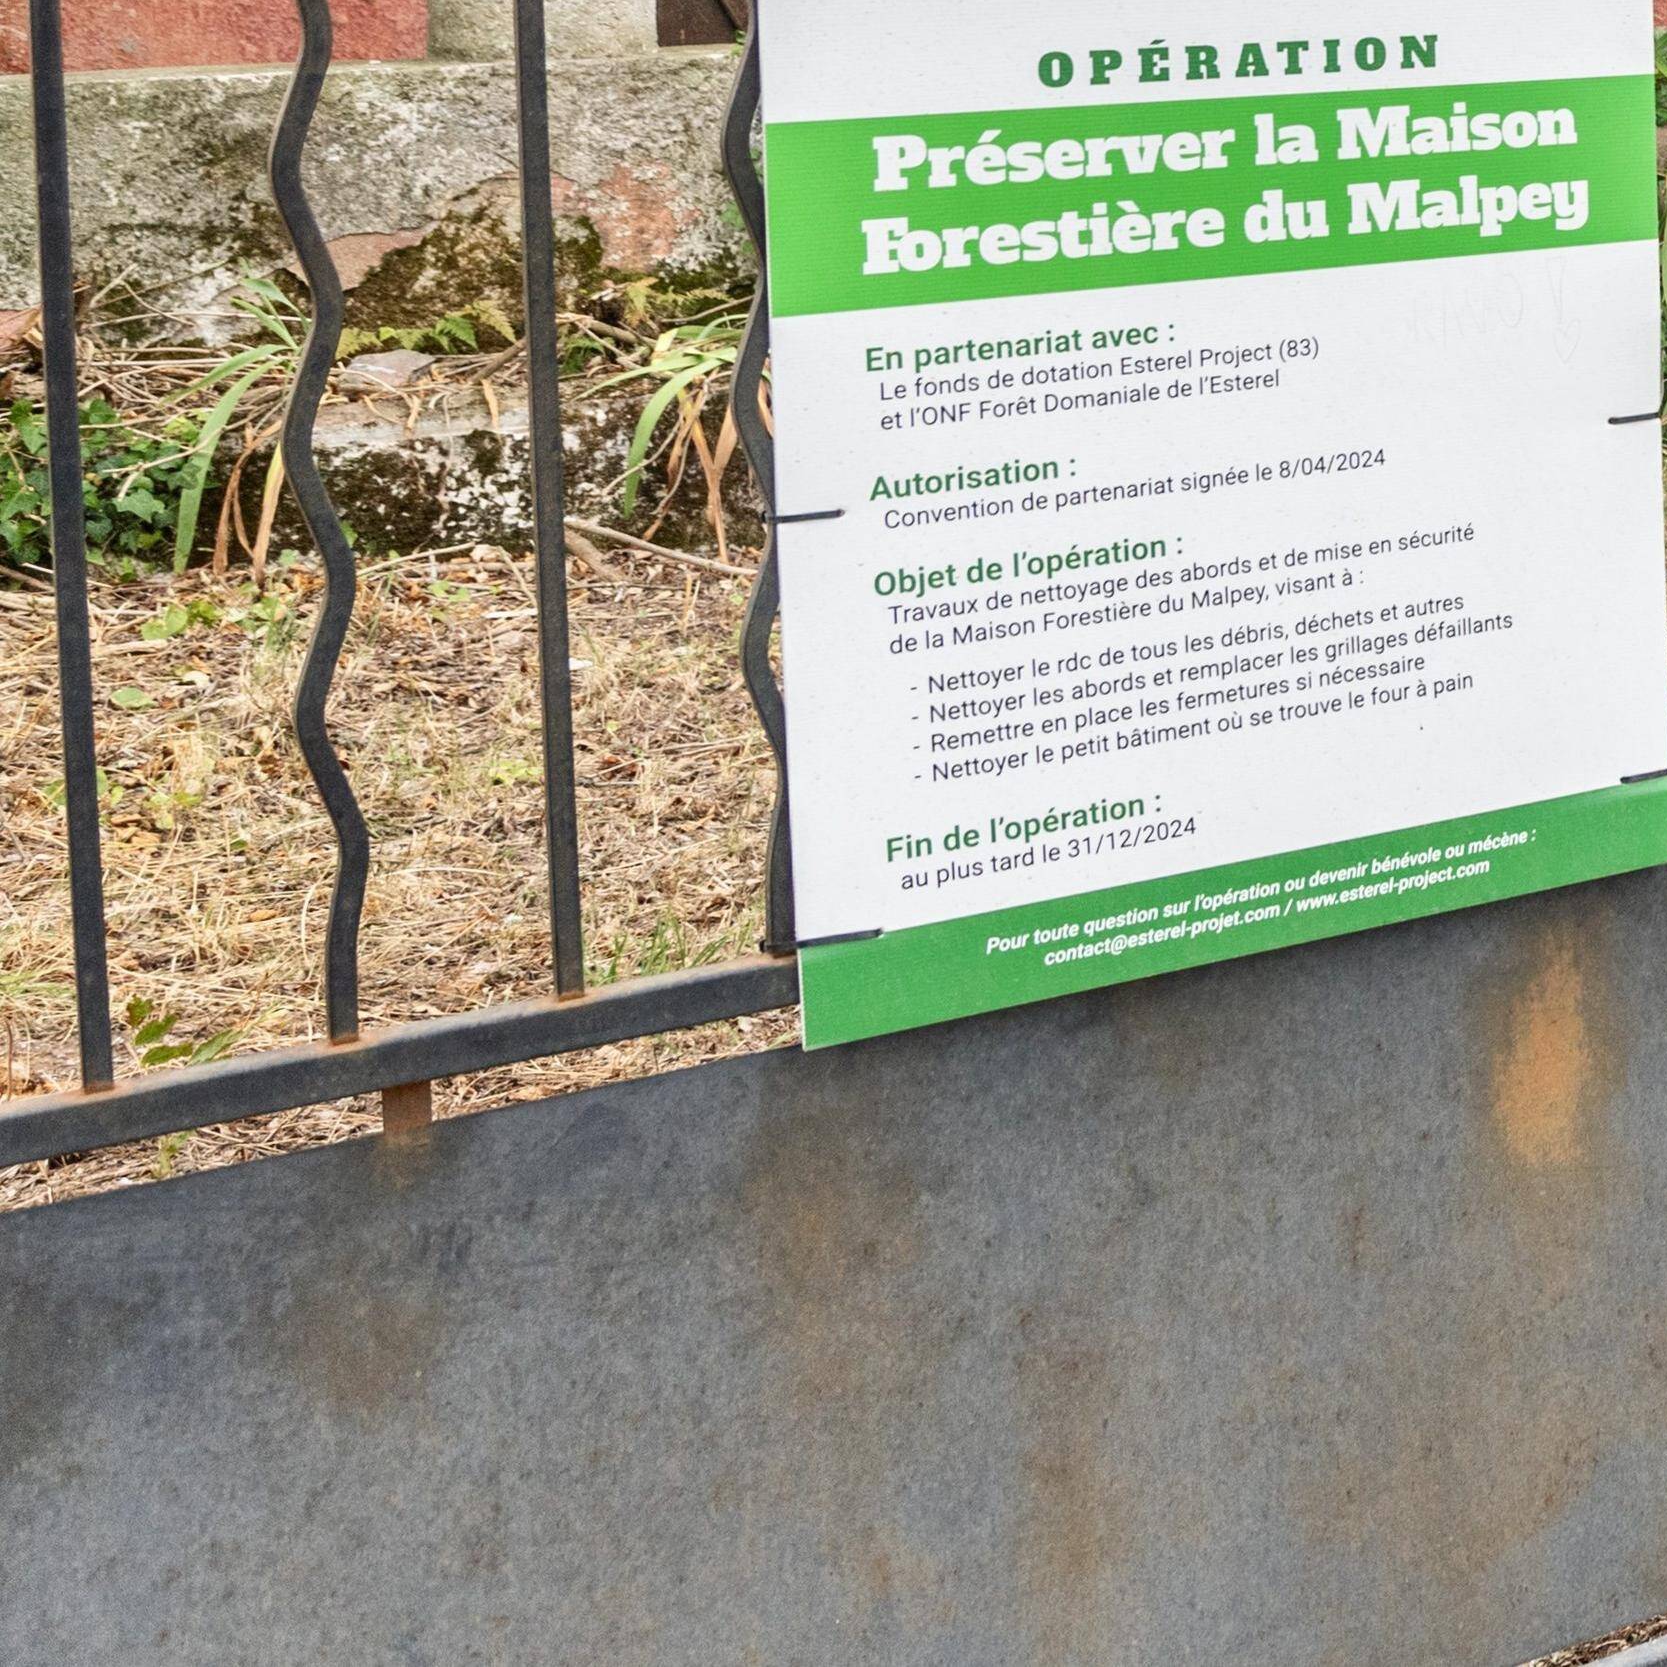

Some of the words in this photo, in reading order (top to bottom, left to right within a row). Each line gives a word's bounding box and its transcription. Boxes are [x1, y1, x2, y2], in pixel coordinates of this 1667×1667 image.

[1037, 33, 1439, 89] OPÉRATION
[871, 128, 1236, 193] Préserver
[1253, 112, 1320, 166] la
[1335, 100, 1579, 160] Maison
[860, 199, 1225, 276] Forestière
[1243, 188, 1330, 244] du
[1346, 173, 1590, 238] Malpey
[865, 346, 903, 373] En
[914, 328, 1083, 373] partenariat
[1091, 325, 1159, 350] avec
[879, 381, 908, 401] Le
[913, 372, 980, 397] fonds
[986, 368, 1015, 390] de
[1020, 360, 1113, 386] dotation
[1119, 349, 1193, 376] Esterel
[1199, 343, 1273, 369] Project
[1278, 336, 1319, 363] (83)
[880, 410, 903, 431] et
[978, 395, 1037, 420] Forêt
[1043, 382, 1161, 413] Domaniale
[1166, 378, 1193, 399] de
[869, 458, 1059, 502] Autorisation
[883, 498, 1014, 530] Convention
[1020, 491, 1049, 512] de
[1054, 476, 1174, 513] partenariat
[1180, 465, 1249, 494] signée
[1255, 462, 1273, 482] le
[1278, 448, 1386, 479] 8/04/2024
[873, 563, 957, 597] Objet
[965, 556, 1003, 584] de
[887, 597, 979, 625] Travaux
[985, 589, 1013, 611] de
[1020, 576, 1129, 606] nettoyage
[1134, 568, 1173, 590] des
[1179, 555, 1252, 583] abords
[1257, 552, 1278, 572] et
[1283, 547, 1308, 568] de
[1314, 541, 1363, 564] mise
[1368, 538, 1392, 555] en
[1397, 521, 1475, 551] sécurité
[889, 633, 918, 655] de
[924, 629, 944, 650] la
[952, 618, 1036, 646] Maison
[1042, 600, 1152, 632] Forestière
[1157, 593, 1184, 615] du
[1190, 584, 1270, 609] Malpey,
[1274, 571, 1336, 596] visant
[1341, 567, 1353, 587] à
[927, 664, 1025, 694] Nettoyer
[1031, 657, 1051, 678] le
[1057, 651, 1092, 674] rdc
[1097, 646, 1125, 668] de
[1129, 640, 1178, 662] tous
[1184, 633, 1215, 654] les
[1220, 623, 1289, 648] débris,
[1294, 609, 1374, 636] déchets
[1379, 603, 1399, 622] et
[1403, 595, 1465, 619] autres
[929, 693, 1026, 723] Nettoyer
[1032, 686, 1065, 707] les
[1071, 671, 1147, 701] abords
[1152, 667, 1173, 687] et
[1179, 651, 1284, 683] remplacer
[1289, 645, 1319, 665] les
[1324, 631, 1409, 663] grillages
[1413, 614, 1513, 644] défaillants
[930, 721, 1034, 753] Remettre
[1040, 716, 1068, 734] en
[1074, 705, 1133, 734] place
[1139, 698, 1170, 718] les
[1175, 678, 1290, 711] fermetures
[1295, 670, 1312, 691] si
[1318, 655, 1425, 687] nécessaire
[932, 751, 1029, 782] Nettoyer
[1035, 744, 1054, 764] le
[1060, 734, 1110, 765] petit
[1115, 717, 1211, 751] bâtiment
[1216, 710, 1243, 733] où
[1248, 709, 1273, 727] se
[1278, 697, 1343, 722] trouve
[1347, 690, 1365, 709] le
[1370, 685, 1411, 705] four
[1415, 678, 1428, 698] à
[1432, 672, 1473, 699] pain
[886, 833, 933, 863] Fin
[942, 824, 980, 852] de
[900, 871, 929, 891] au
[936, 860, 984, 889] plus
[989, 845, 1035, 873] tard
[1041, 843, 1061, 863] le
[1067, 816, 1197, 858] 31/12/2024
[985, 932, 1030, 955] Pour
[1032, 922, 1080, 945] toute
[1082, 906, 1159, 938] question
[1162, 899, 1192, 918] sur
[1283, 876, 1306, 893] ou
[1308, 861, 1369, 888] devenir
[1370, 845, 1442, 875] bénévole
[1443, 843, 1465, 860] ou
[1467, 830, 1529, 855] mécène
[1043, 903, 1281, 966] contact@esterel-projet.com
[1295, 859, 1490, 913] www.esterel-project.com
